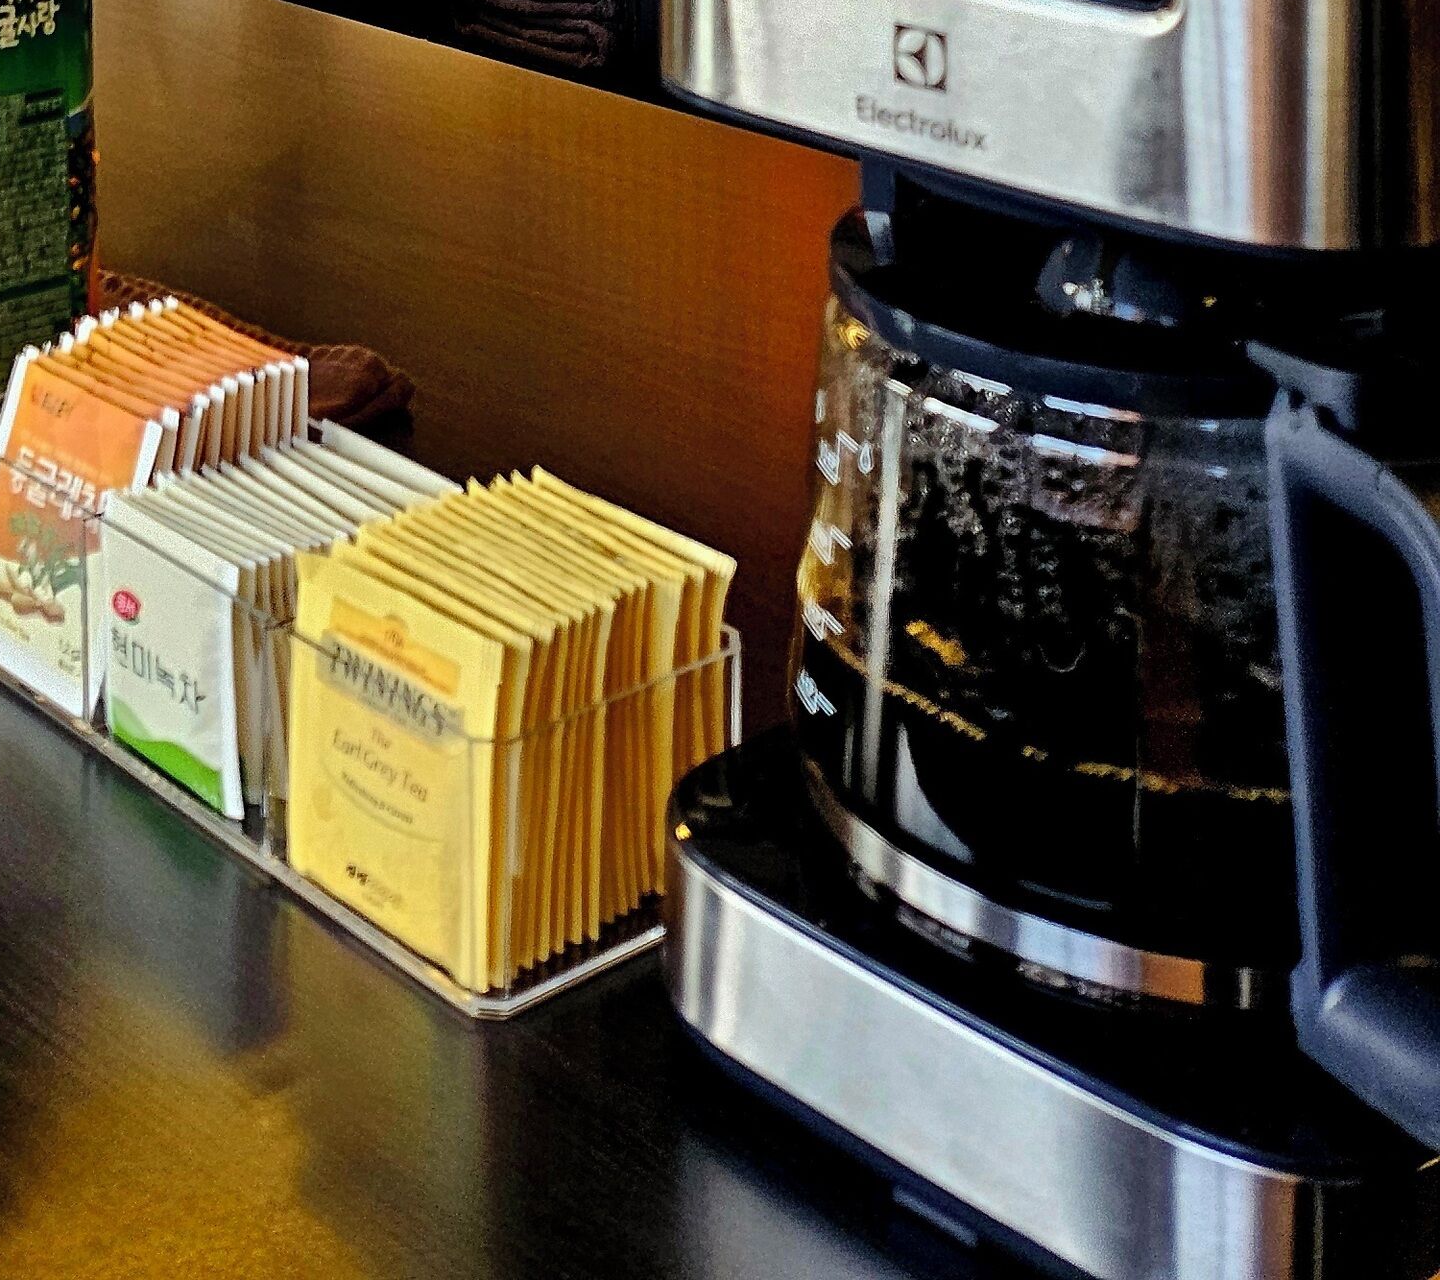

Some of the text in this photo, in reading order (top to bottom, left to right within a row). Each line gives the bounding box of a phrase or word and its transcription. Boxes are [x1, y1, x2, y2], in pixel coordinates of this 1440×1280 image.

[856, 94, 988, 151] Electrolux
[111, 627, 205, 715] 현미녹차
[333, 727, 361, 761] Earl
[363, 751, 398, 786] Grey
[402, 769, 429, 803] Tea
